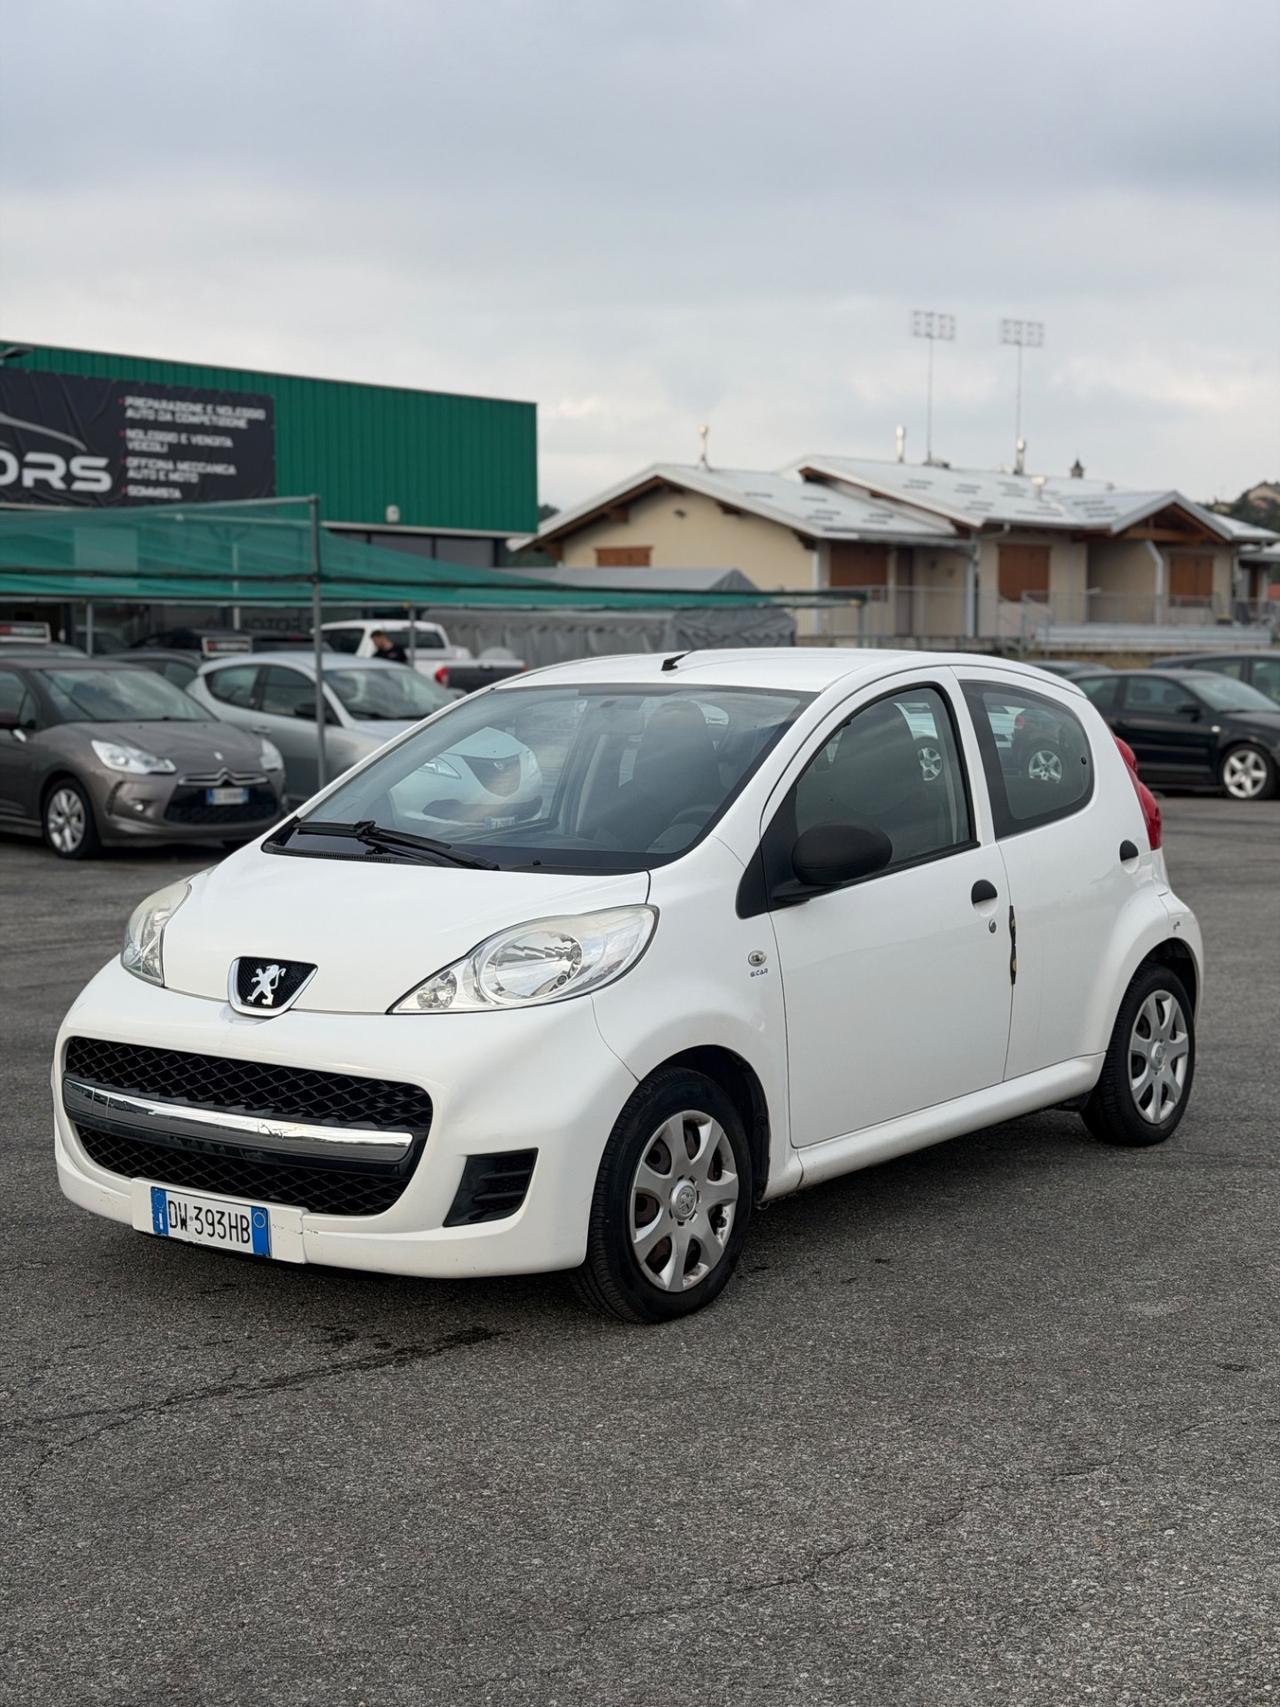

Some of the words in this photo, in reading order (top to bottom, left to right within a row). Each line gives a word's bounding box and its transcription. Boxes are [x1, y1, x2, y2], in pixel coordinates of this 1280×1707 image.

[125, 408, 156, 420] AUTO
[157, 410, 173, 422] DA
[127, 468, 158, 480] AUTO
[168, 472, 199, 483] MOTO
